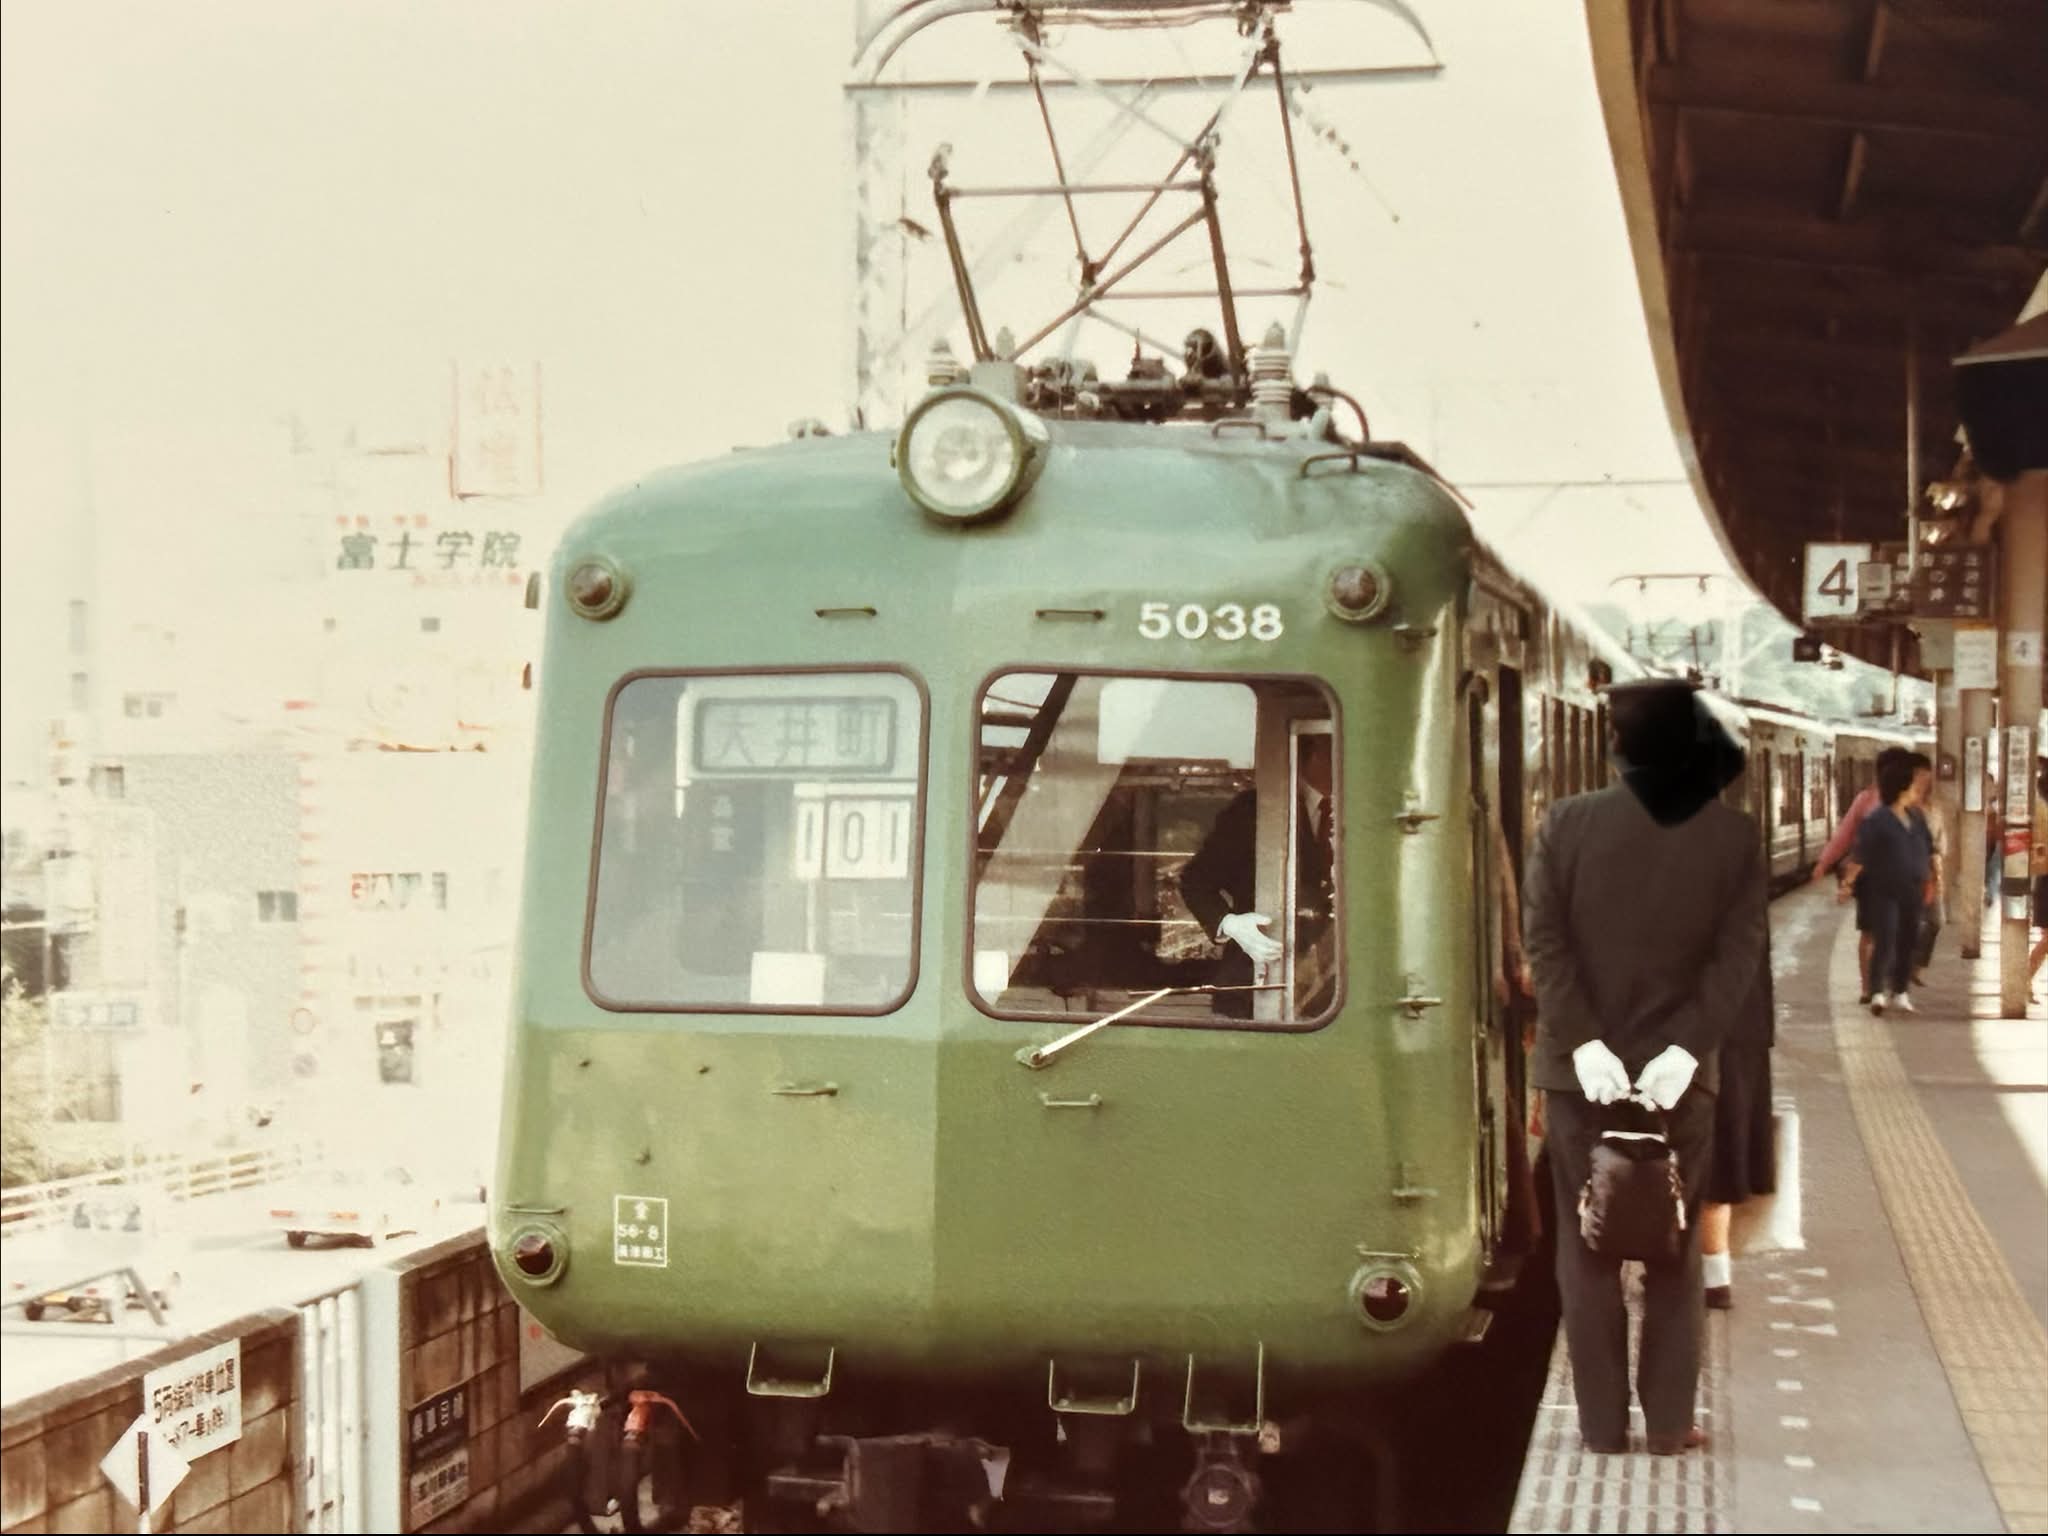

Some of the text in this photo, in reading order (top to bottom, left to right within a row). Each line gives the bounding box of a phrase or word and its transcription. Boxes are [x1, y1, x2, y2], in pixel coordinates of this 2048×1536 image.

[336, 530, 522, 571] 富士学院
[1818, 558, 1854, 606] 4
[1138, 602, 1284, 641] 5038
[718, 703, 883, 767] 大井町
